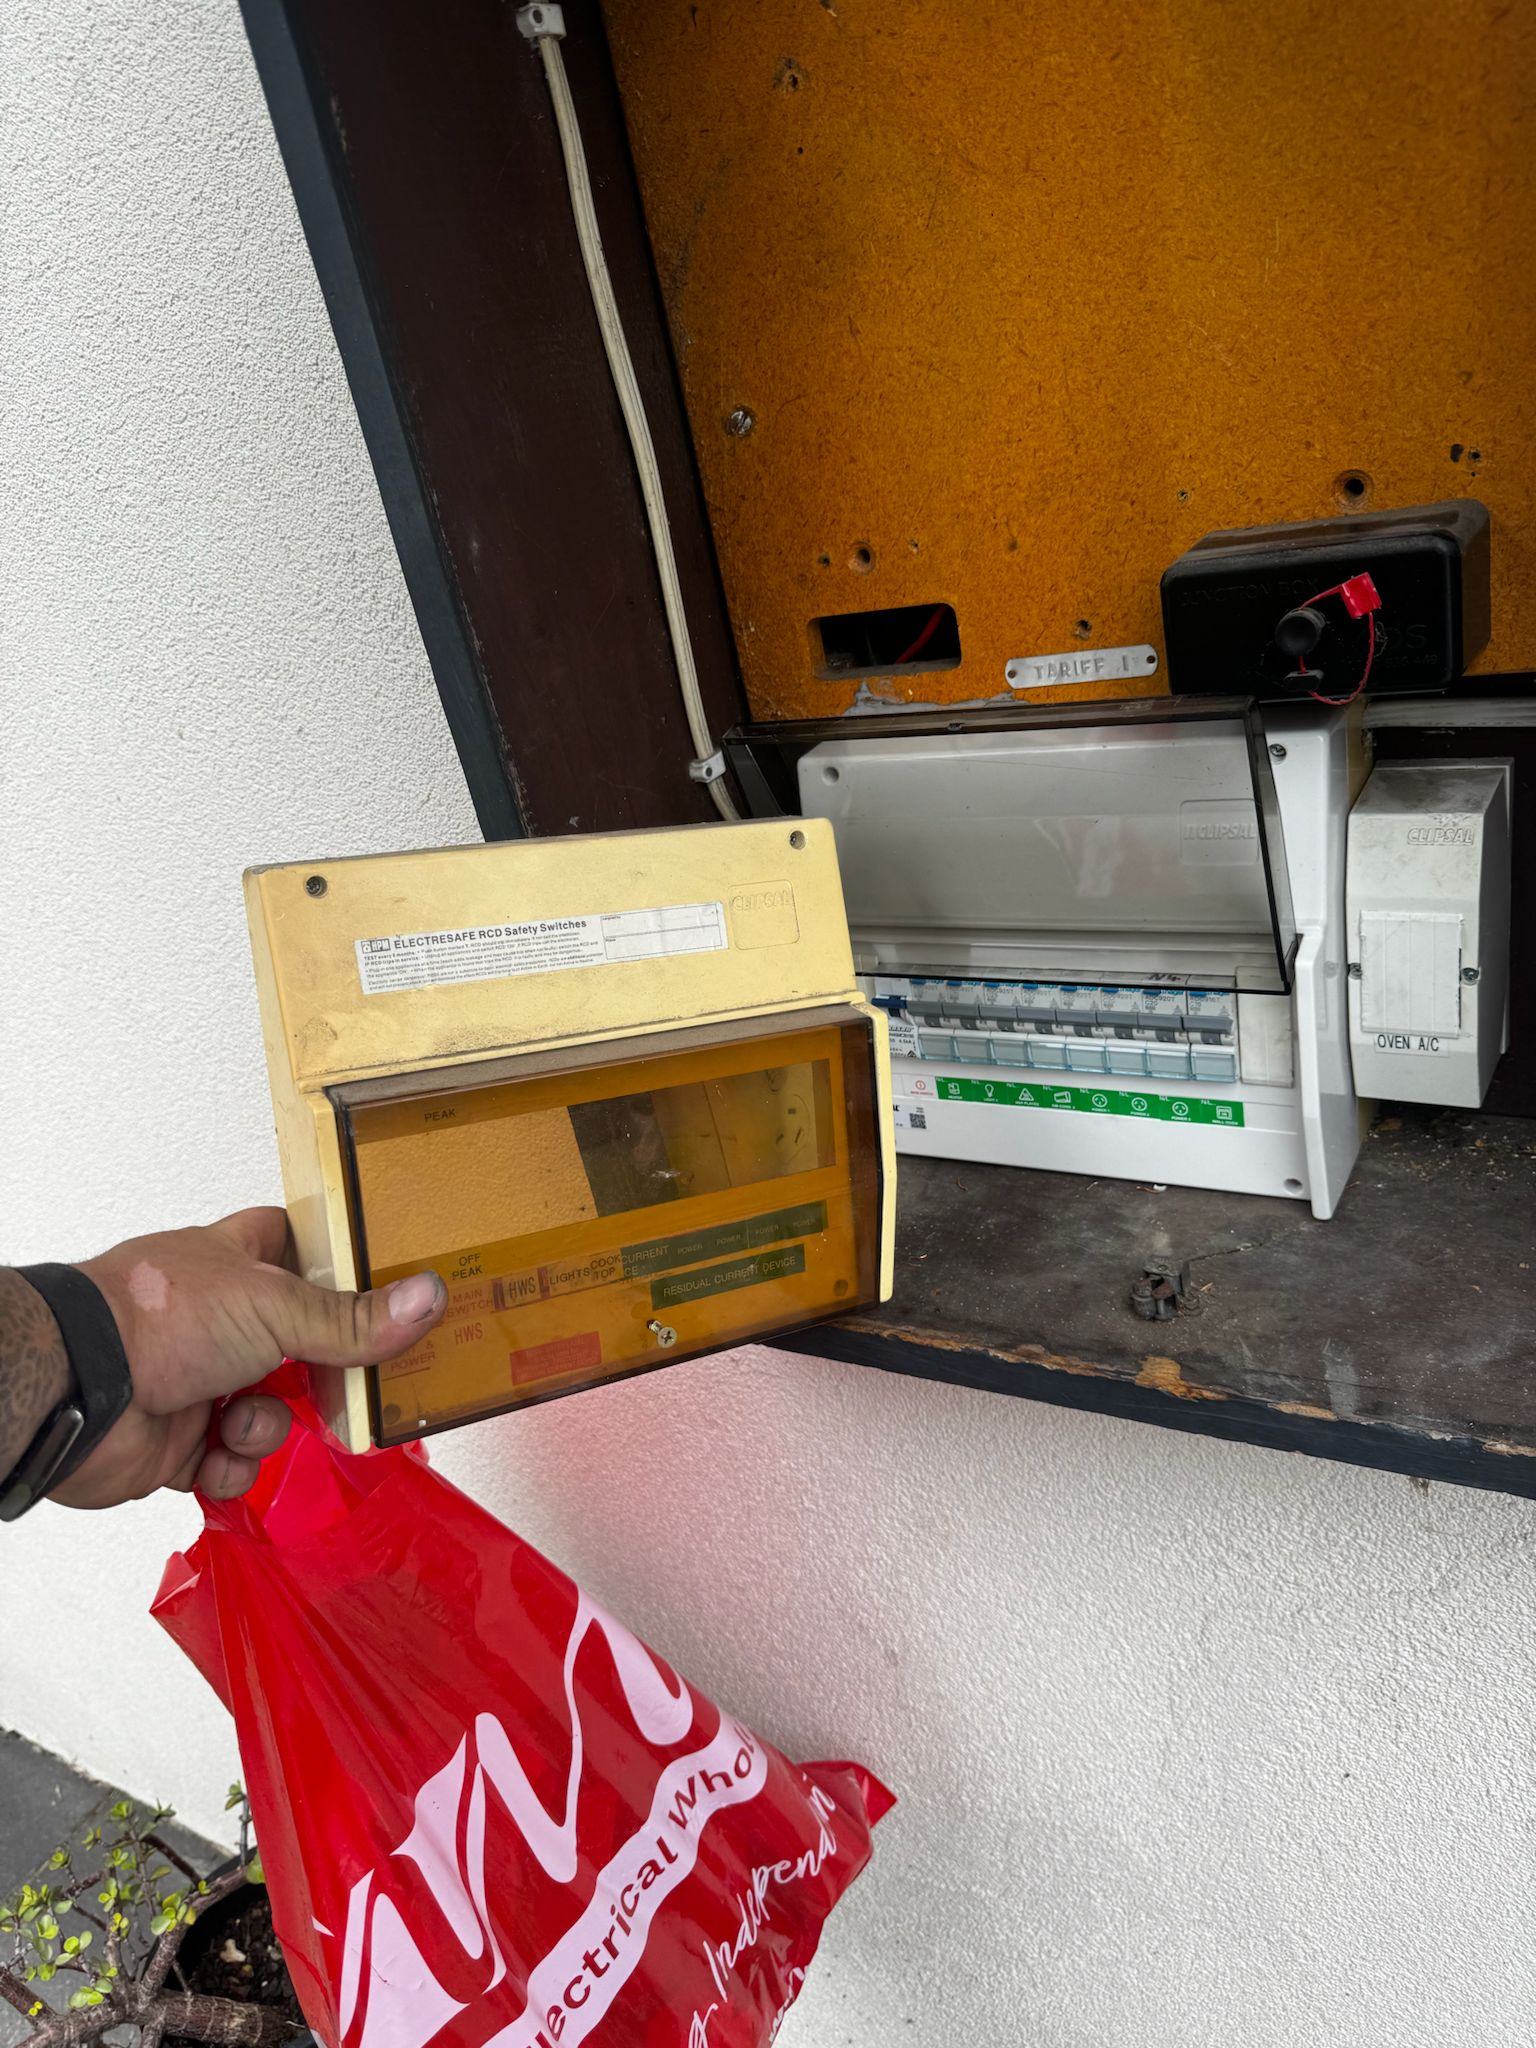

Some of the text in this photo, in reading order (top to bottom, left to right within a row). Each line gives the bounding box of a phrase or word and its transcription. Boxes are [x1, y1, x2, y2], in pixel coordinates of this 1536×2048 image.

[1034, 657, 1105, 680] TARIFF
[1407, 828, 1475, 846] CLIPSAL
[394, 932, 475, 949] ELECTRESAFE
[478, 928, 502, 939] RCD
[505, 923, 538, 937] Safety
[540, 920, 587, 932] Switches
[1377, 1034, 1439, 1052] OVEN A/C
[424, 1108, 456, 1122] PEAK
[458, 1253, 481, 1267] OFF
[591, 1254, 621, 1270] COOK
[621, 1245, 669, 1265] CURRENT
[452, 1265, 483, 1280] PEAK
[550, 1267, 590, 1285] LIGHTS
[594, 1266, 616, 1281] TOP
[663, 1255, 796, 1298] RESIDUAL CURRENT DEVICE
[452, 1288, 483, 1304] MAIN
[508, 1277, 536, 1299] HWS
[454, 1322, 484, 1345] HWS
[391, 1351, 436, 1372] POWER
[526, 1719, 756, 2048] lectrical Whol
